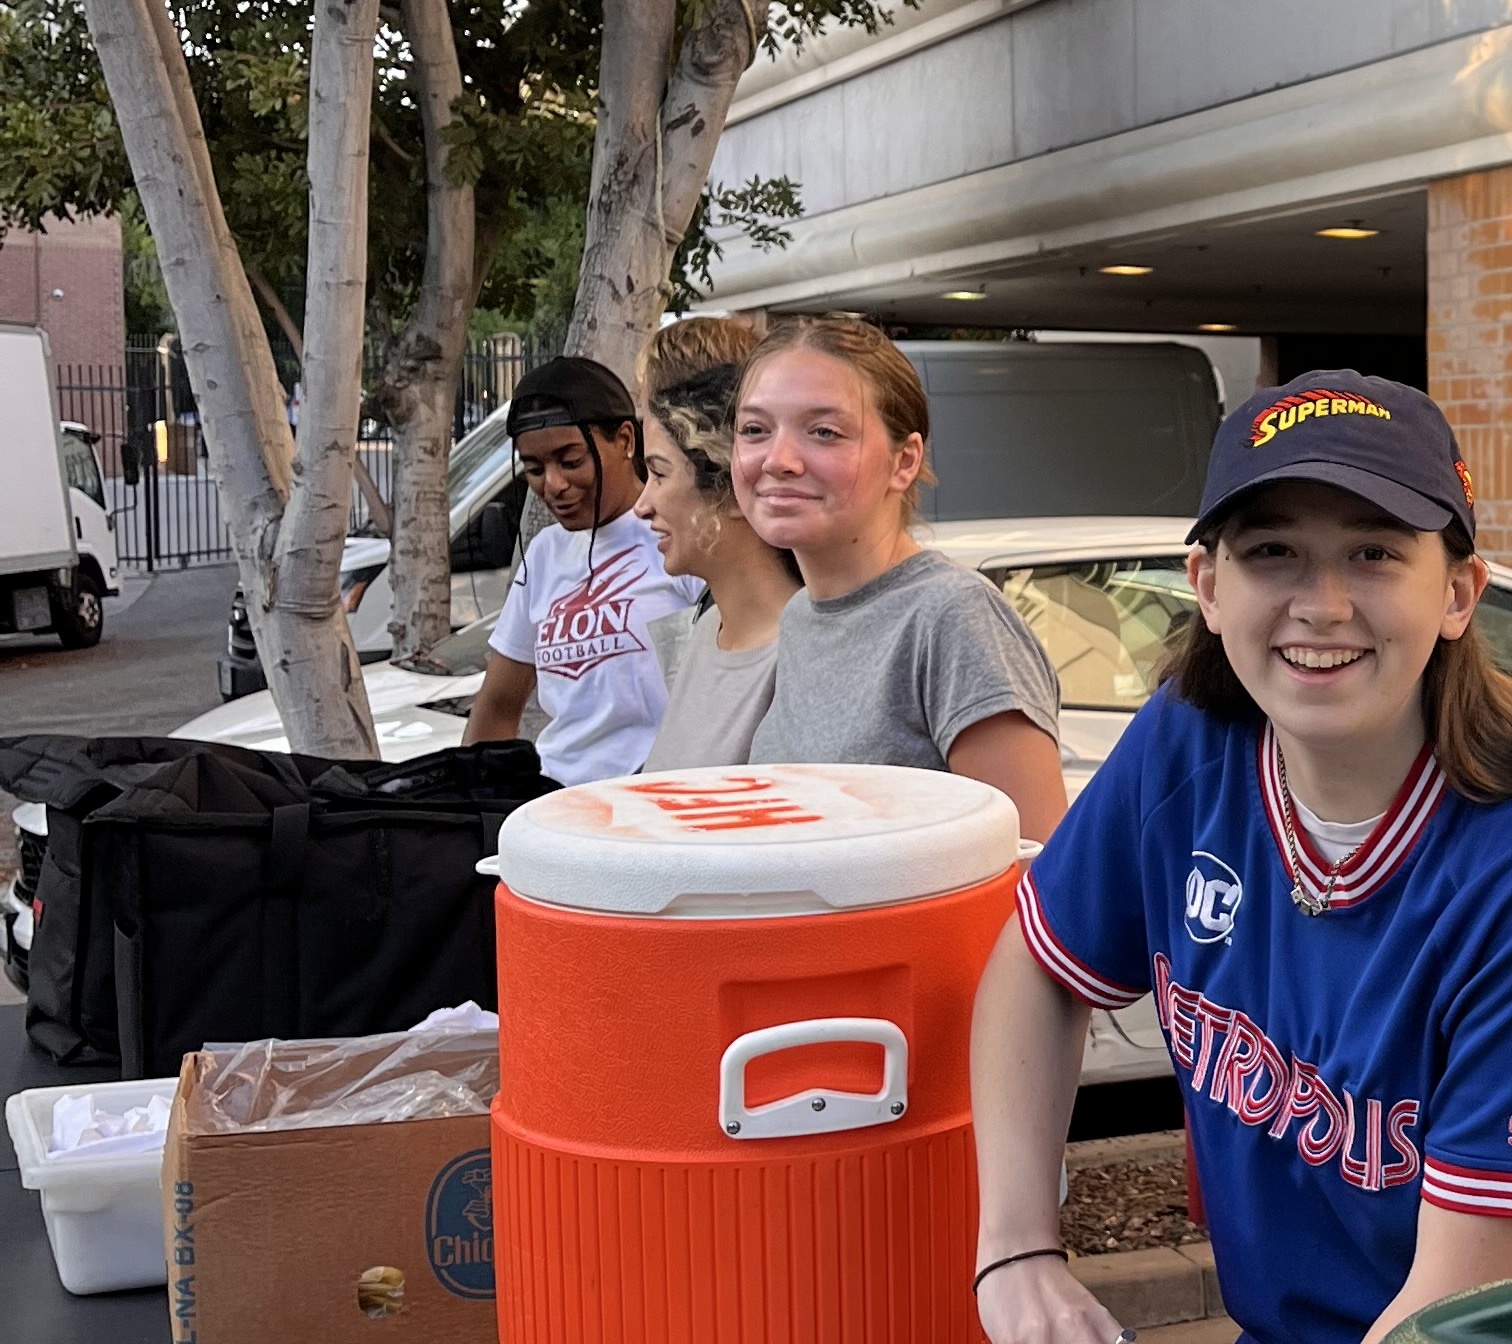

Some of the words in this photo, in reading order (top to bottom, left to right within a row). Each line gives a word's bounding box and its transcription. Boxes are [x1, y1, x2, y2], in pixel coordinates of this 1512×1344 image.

[1252, 394, 1391, 447] SUPERMAN
[537, 601, 630, 646] ELON
[537, 637, 625, 664] FOOTBALL
[1185, 866, 1240, 932] DC
